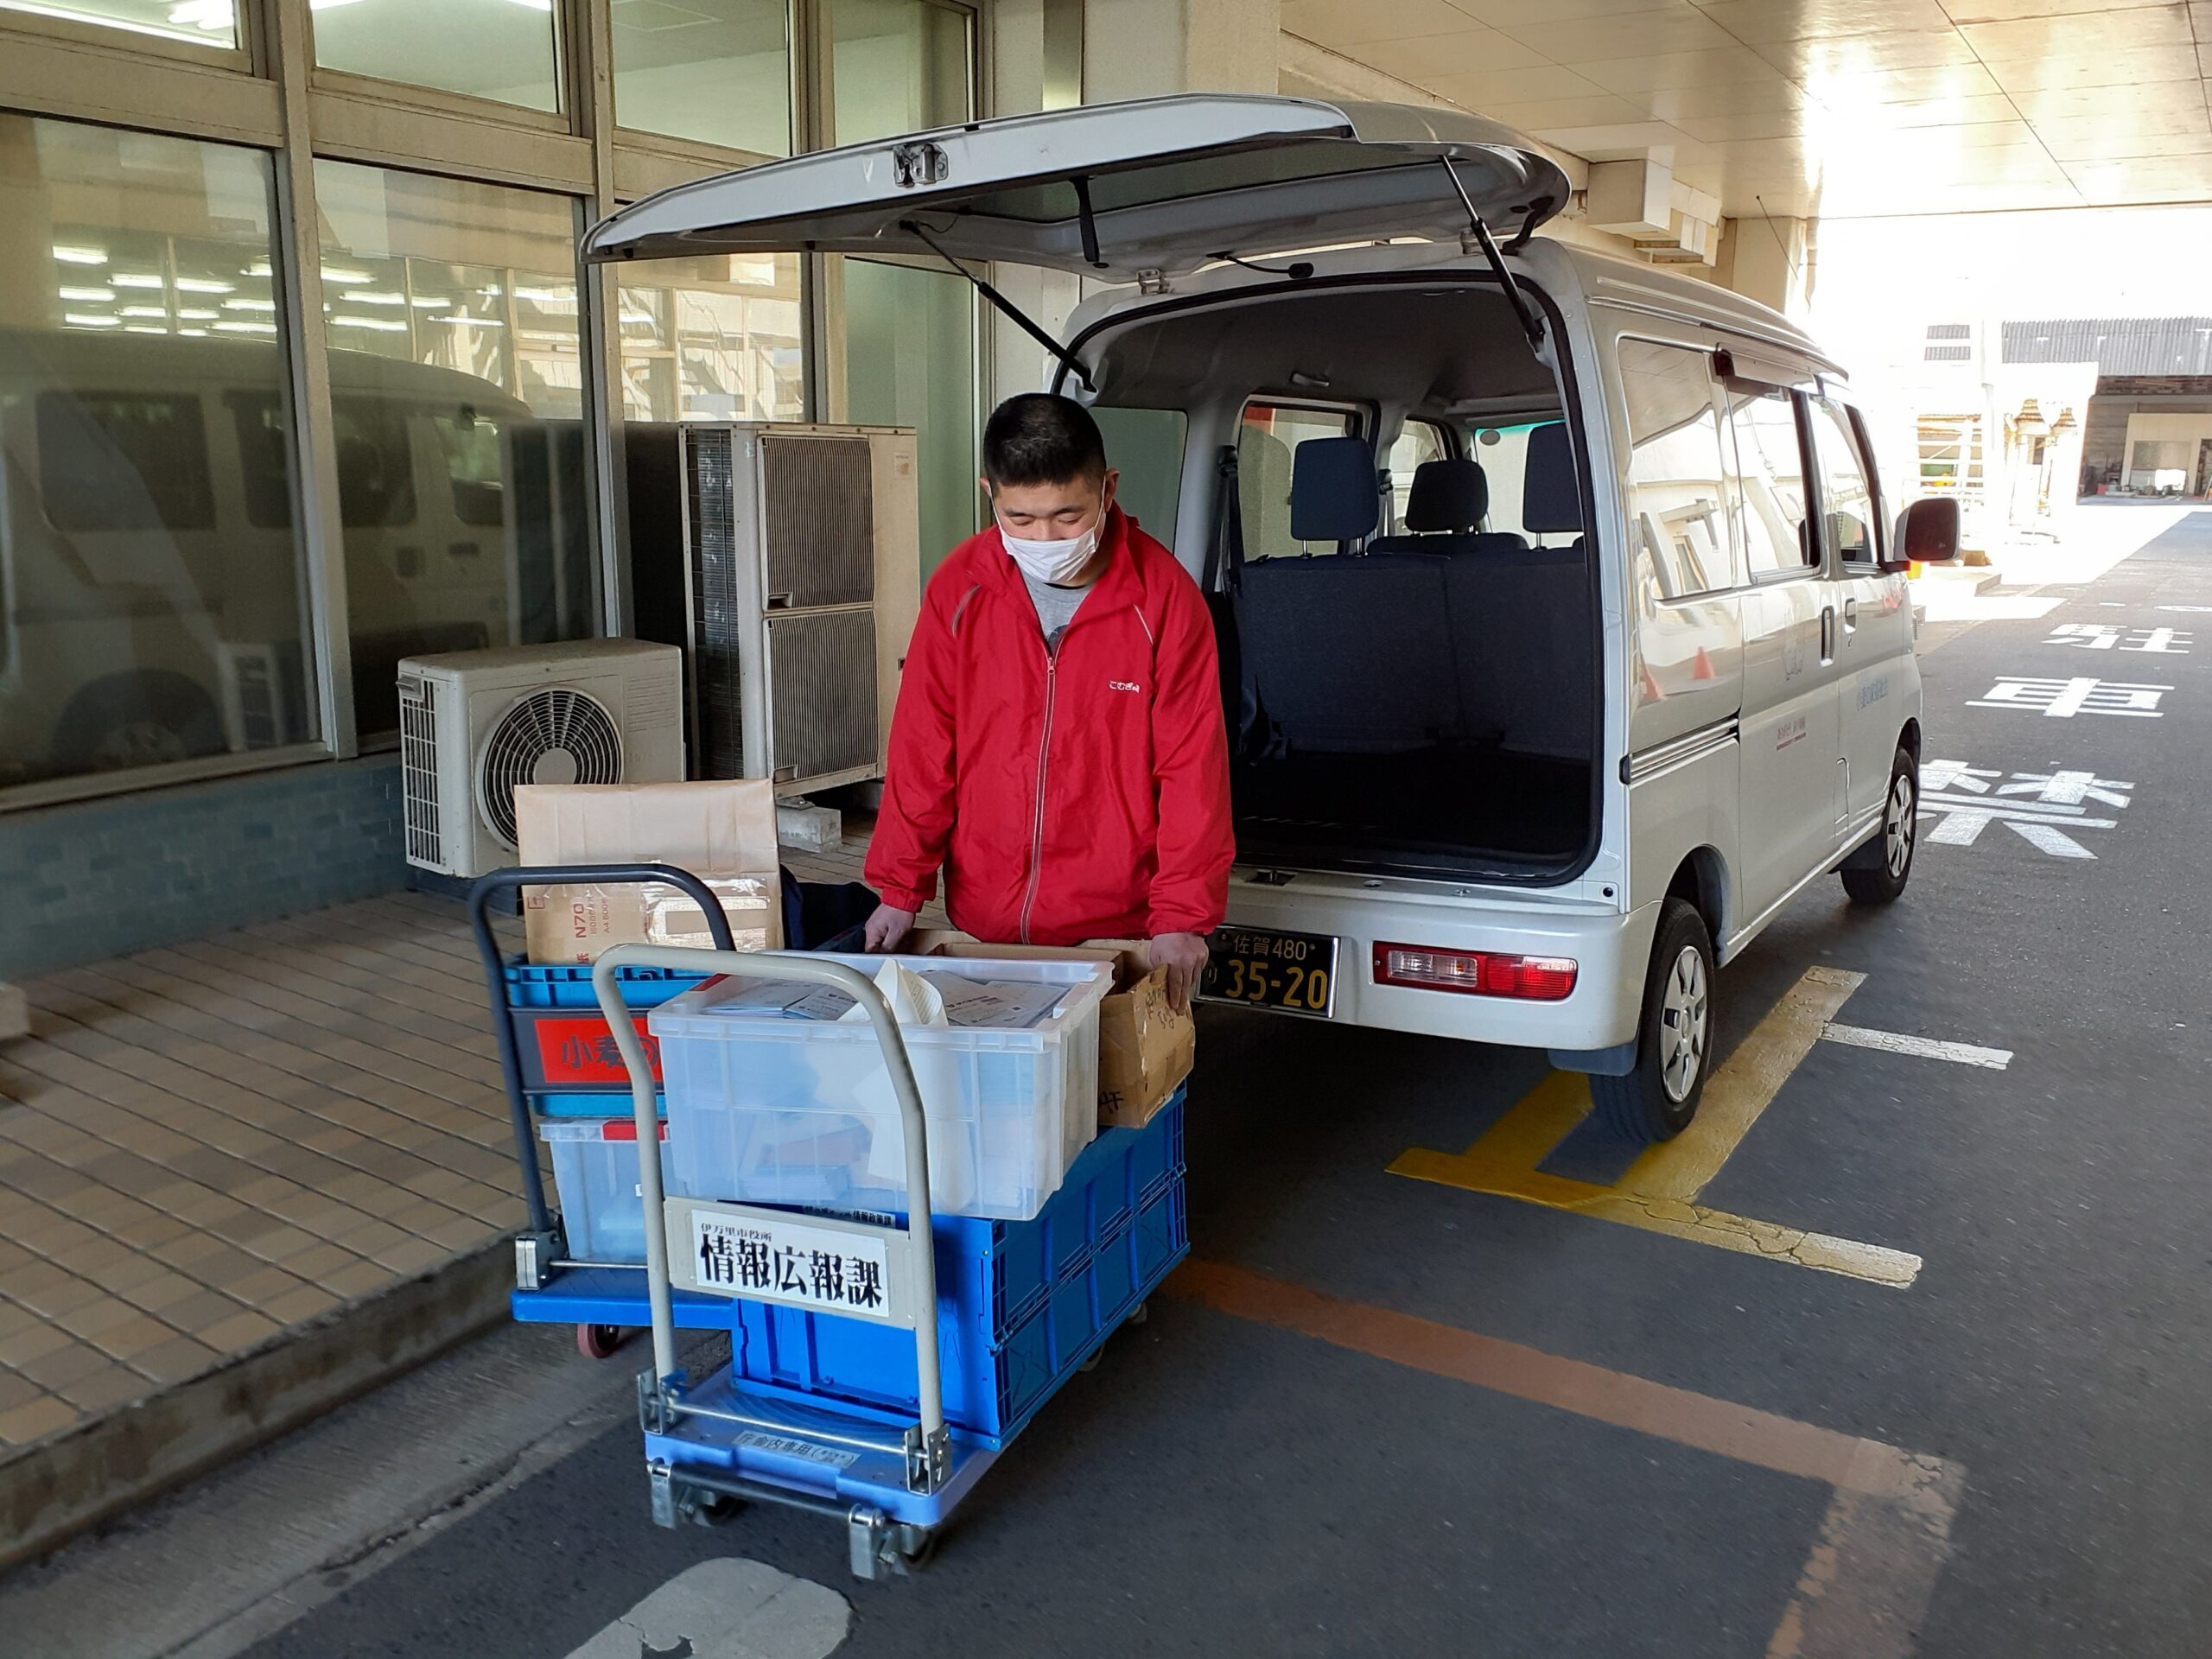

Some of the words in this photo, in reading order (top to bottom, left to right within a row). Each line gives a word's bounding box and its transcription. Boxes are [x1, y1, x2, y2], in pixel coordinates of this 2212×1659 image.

[574, 903, 587, 938] N70
[1225, 959, 1328, 1010] 35-20
[700, 1223, 772, 1242] 伊万里市役所
[700, 1233, 883, 1308] 情報広報課
